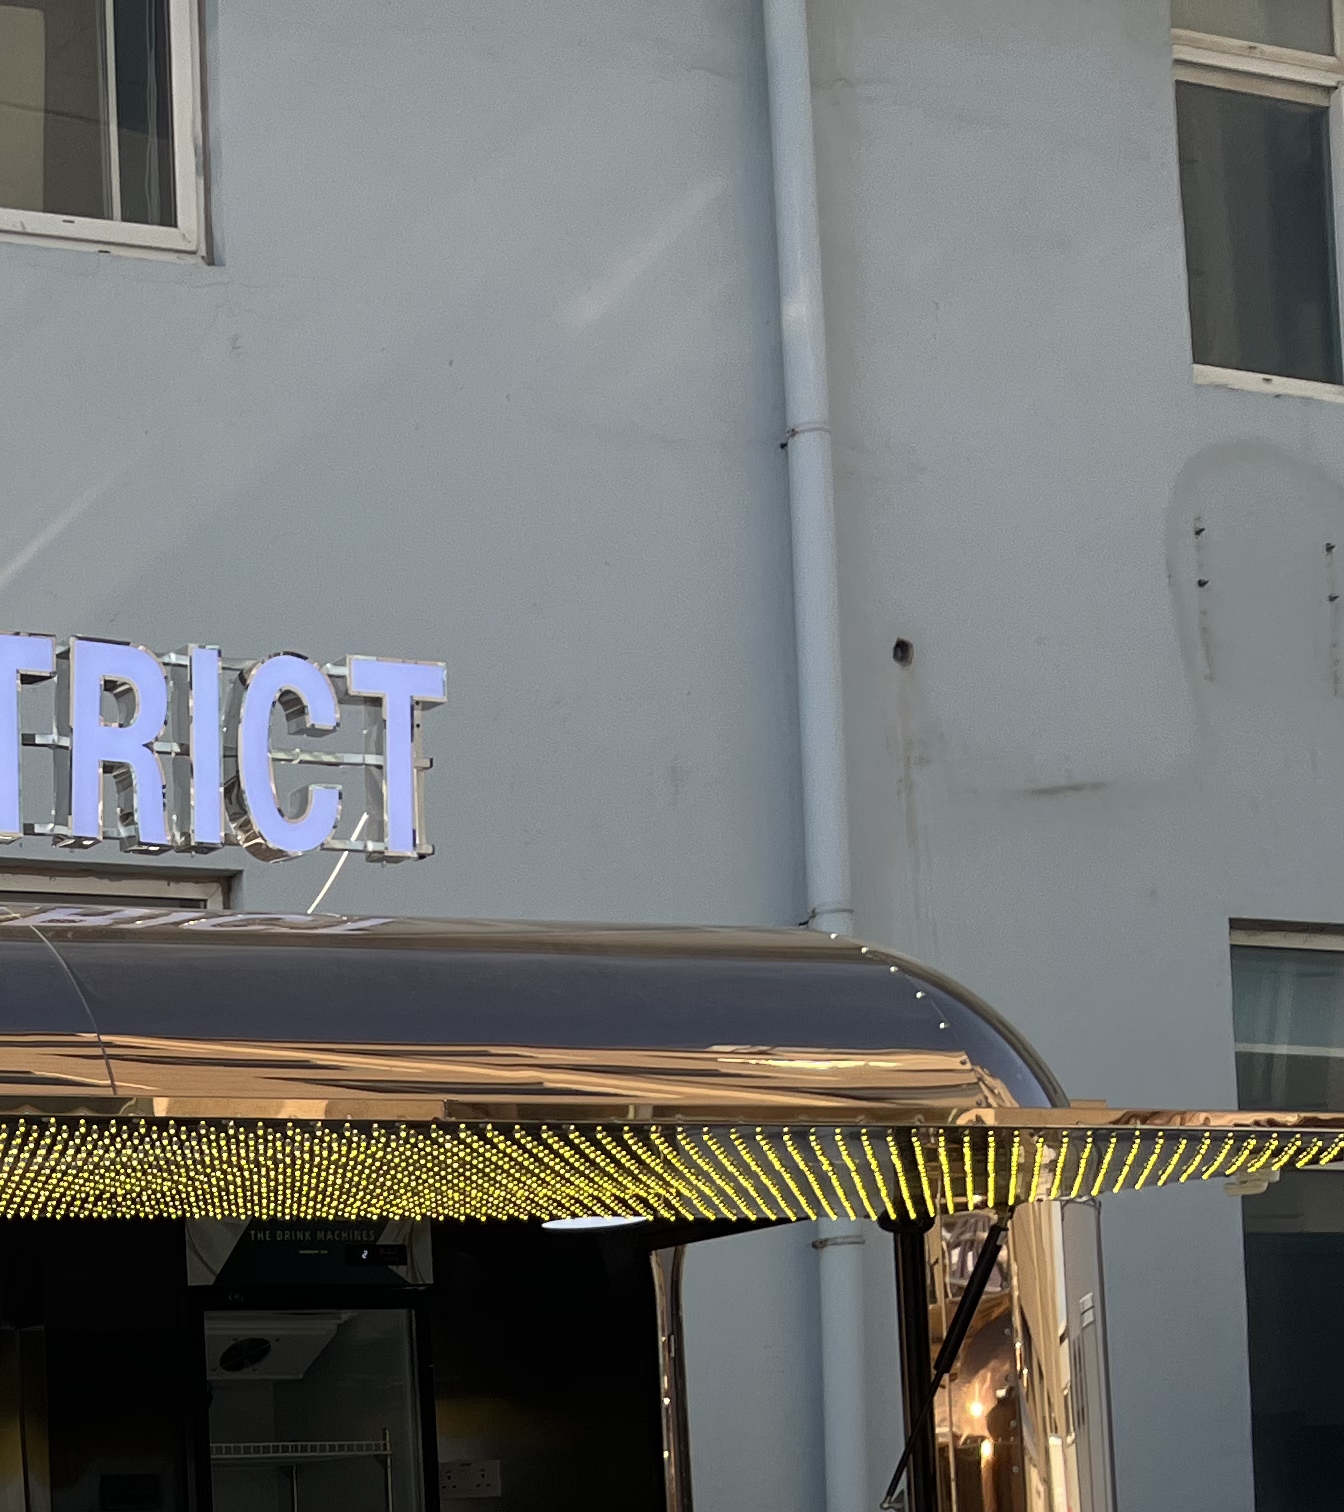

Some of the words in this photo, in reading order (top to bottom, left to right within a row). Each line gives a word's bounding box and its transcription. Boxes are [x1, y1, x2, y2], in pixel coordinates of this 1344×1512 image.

[250, 1229, 272, 1241] THE
[276, 1229, 312, 1241] DRINK
[316, 1229, 375, 1242] MACHINES
